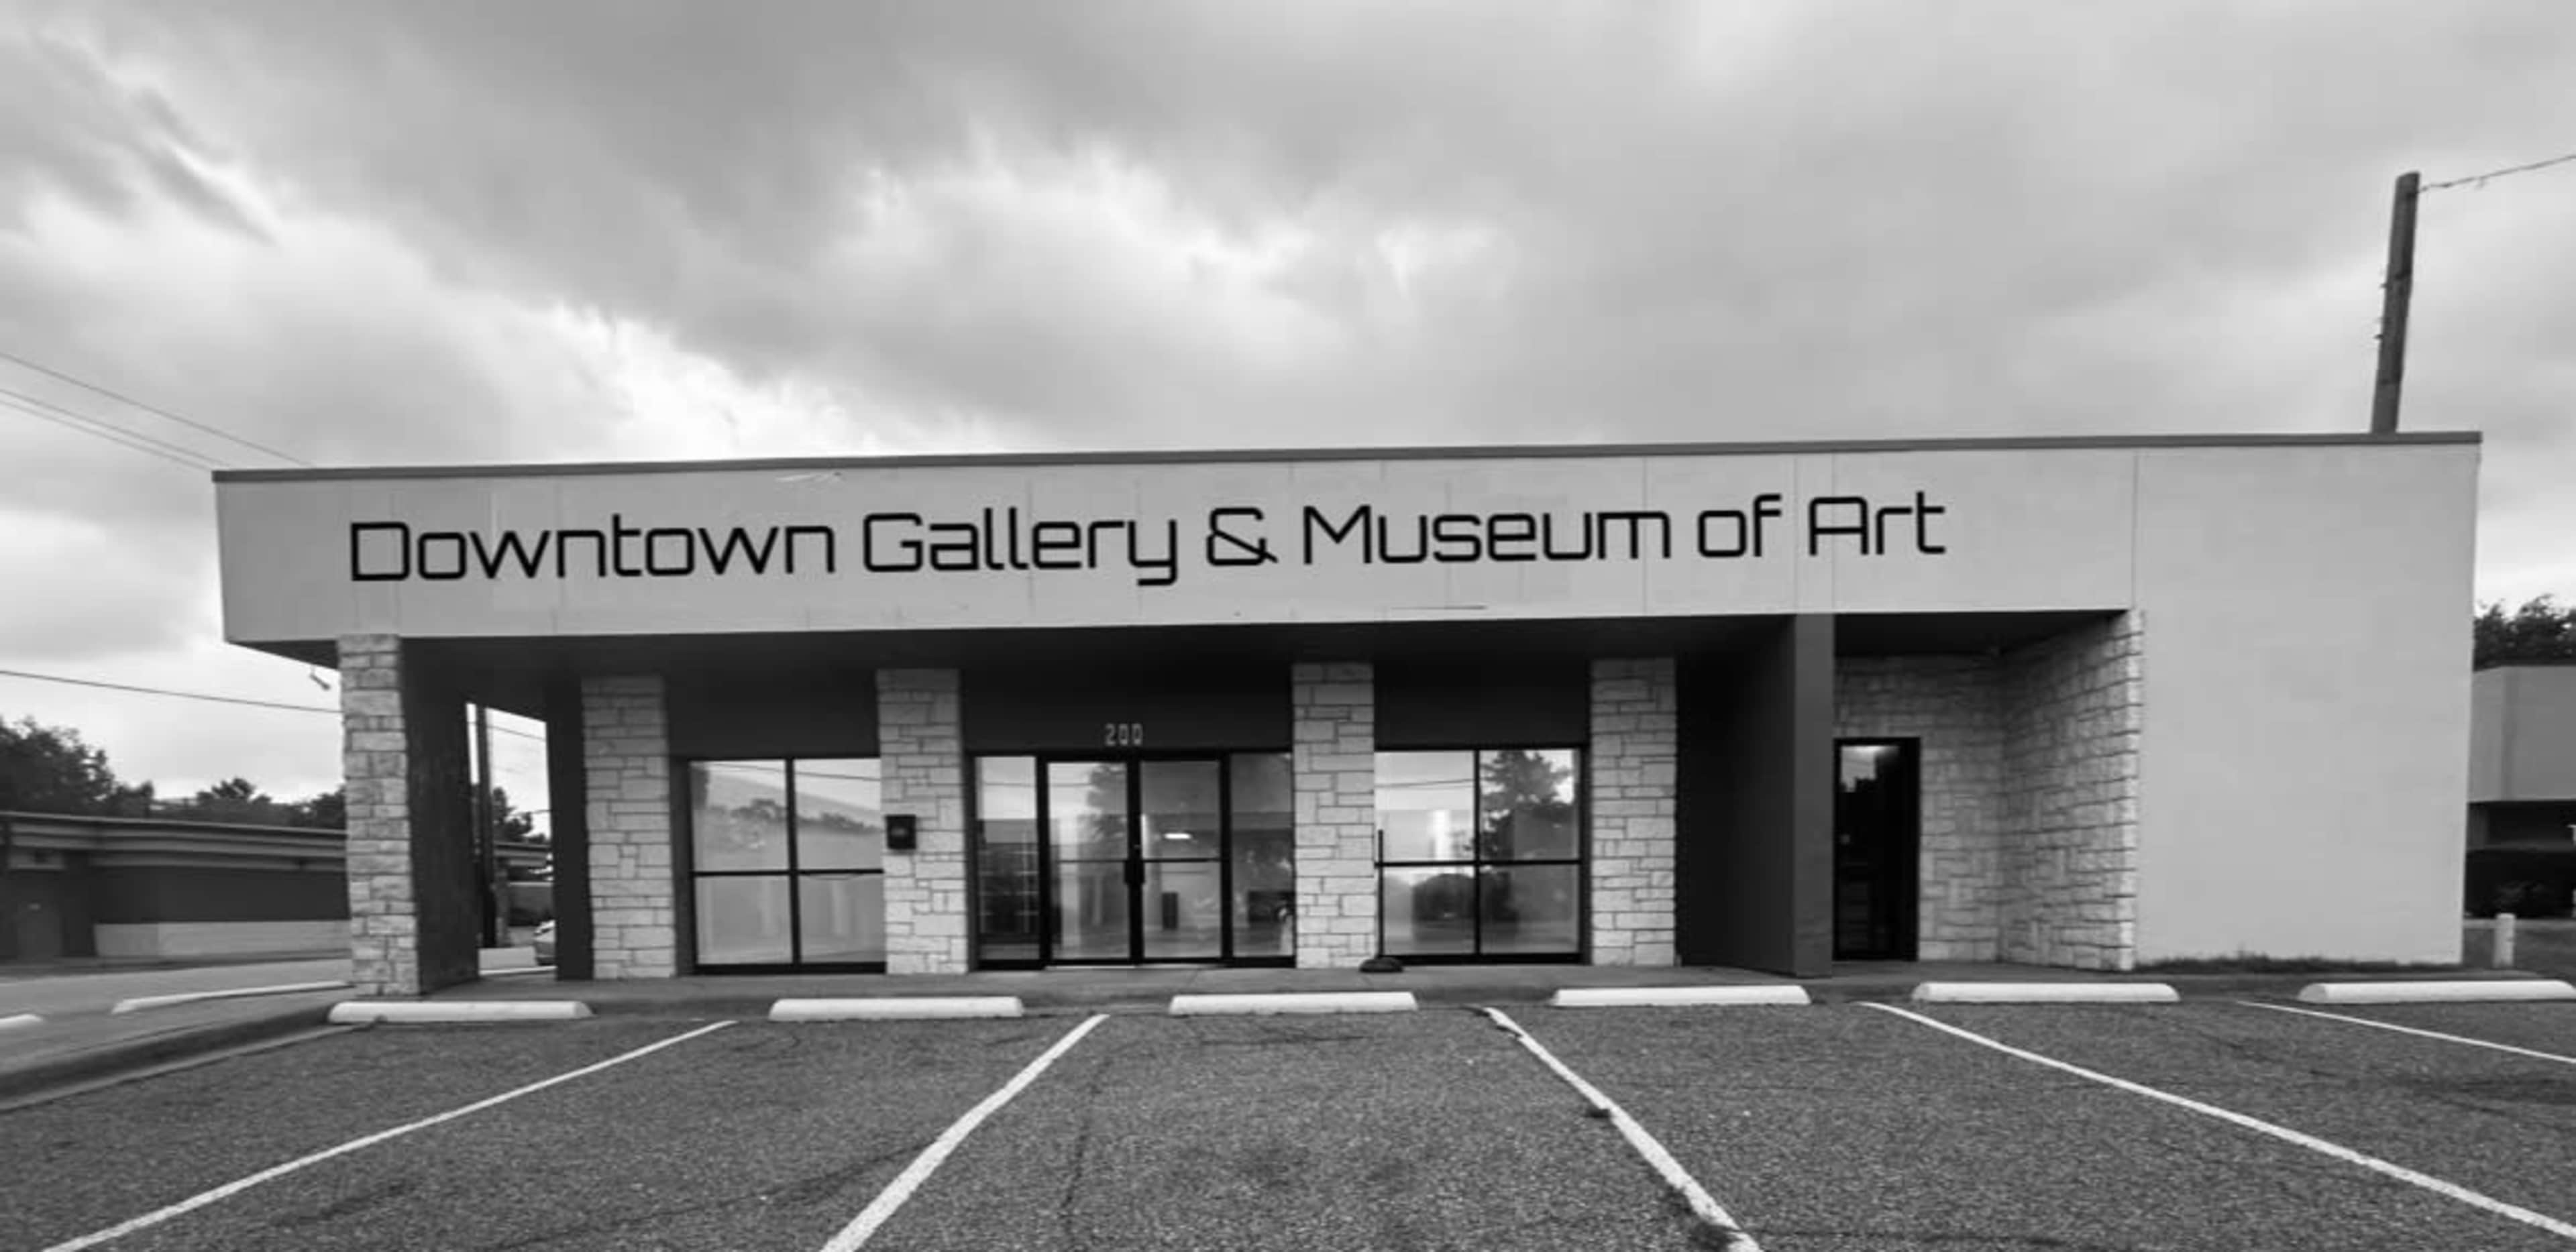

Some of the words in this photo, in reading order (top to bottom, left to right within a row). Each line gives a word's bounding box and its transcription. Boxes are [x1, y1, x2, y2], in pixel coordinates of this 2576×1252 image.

[350, 514, 835, 582] Downtown
[863, 506, 1177, 587] Gallery
[1207, 507, 1278, 567] &
[1303, 505, 1671, 565] Museum
[1697, 494, 1782, 558] of
[1809, 492, 1945, 556] Art
[1106, 724, 1142, 746] 200
